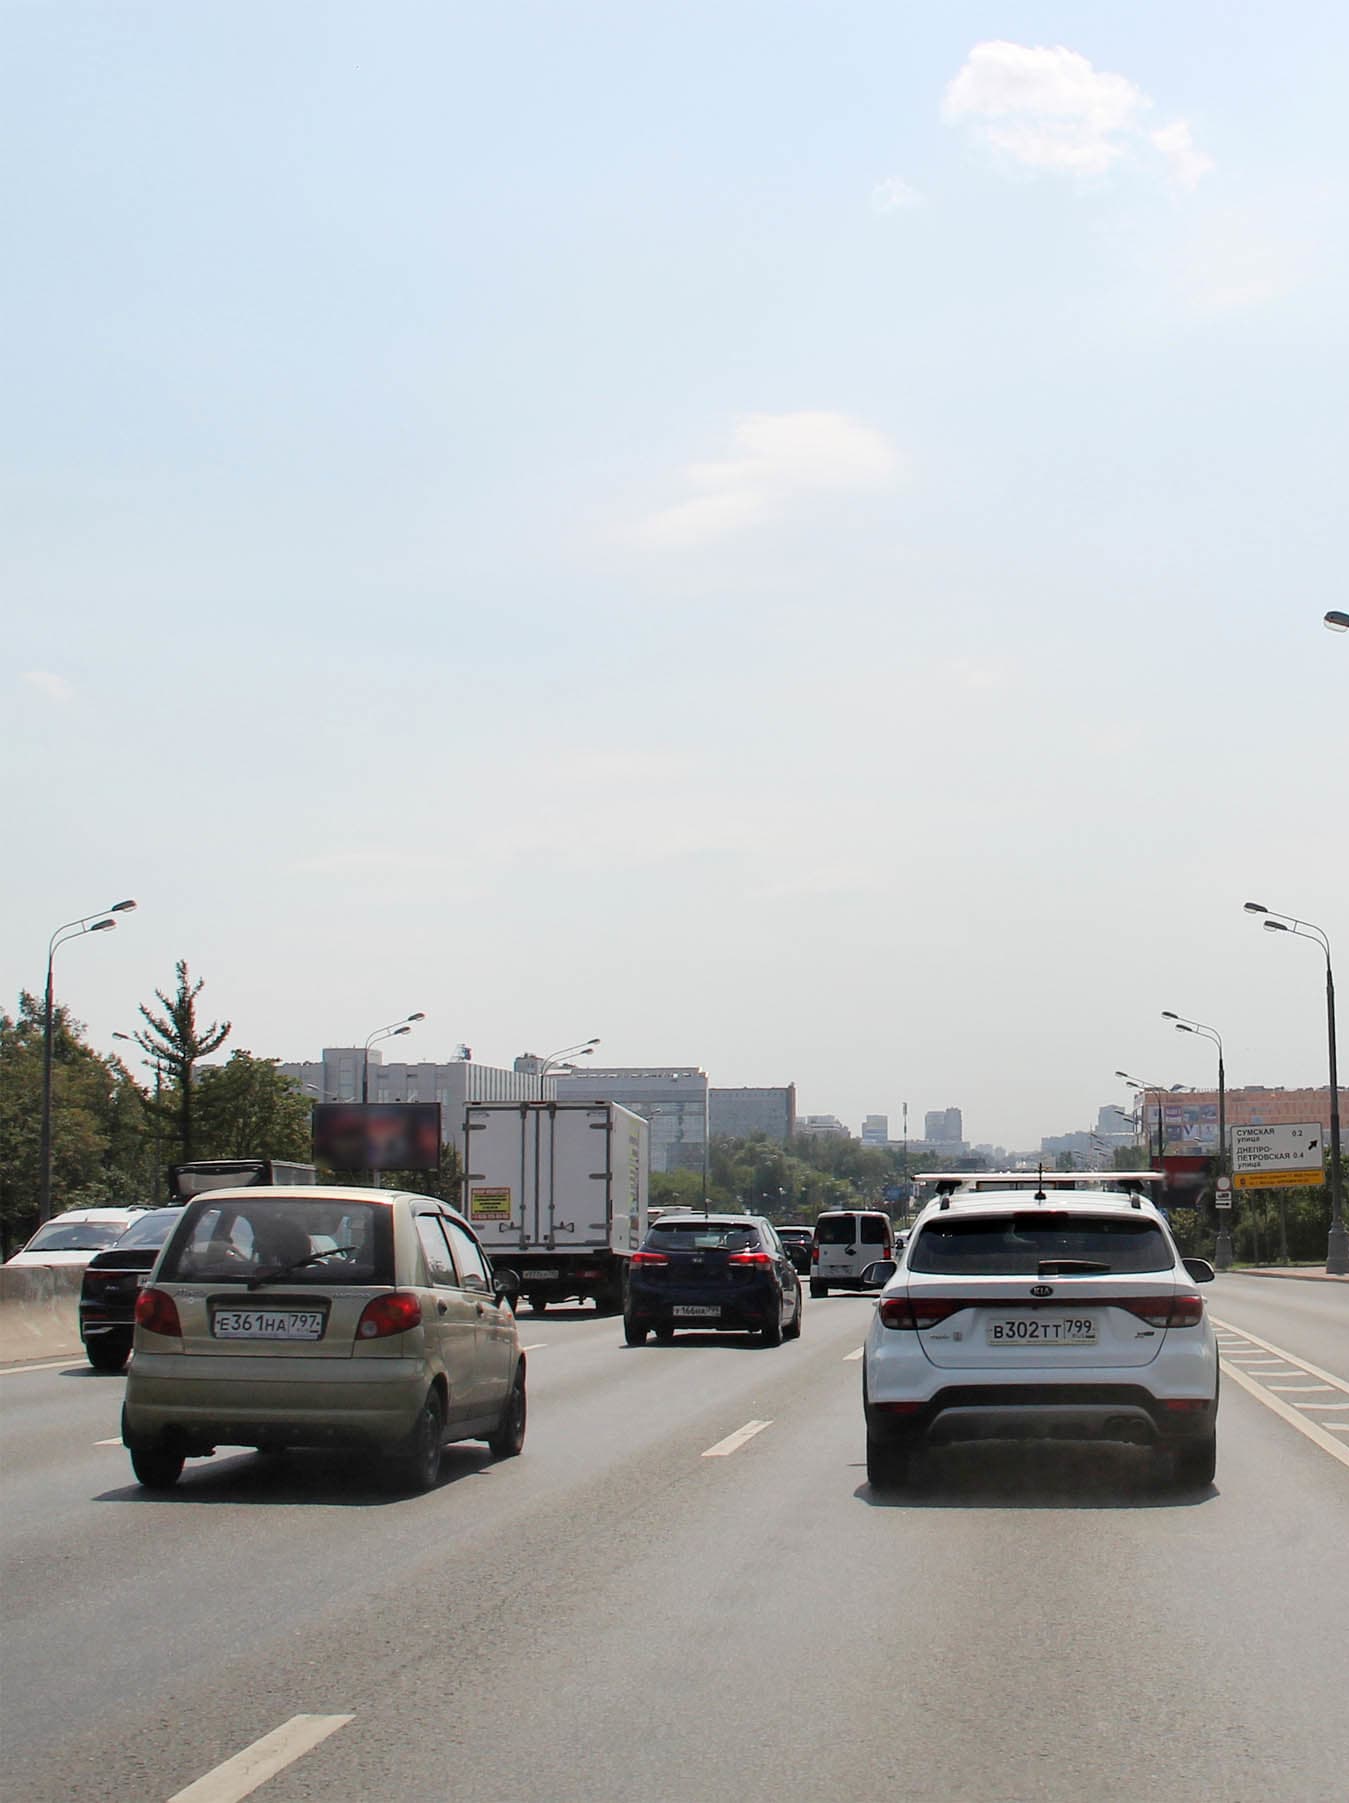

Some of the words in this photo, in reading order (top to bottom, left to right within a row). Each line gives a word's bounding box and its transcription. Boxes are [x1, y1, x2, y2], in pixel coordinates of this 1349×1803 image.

[1236, 1128, 1275, 1137] СУМСКАЯ
[1237, 1136, 1260, 1144] улица
[1236, 1146, 1272, 1154] ДНЕПРО-
[1237, 1153, 1290, 1161] ПЕТРОВСКАЯ
[1033, 1287, 1051, 1296] KIA
